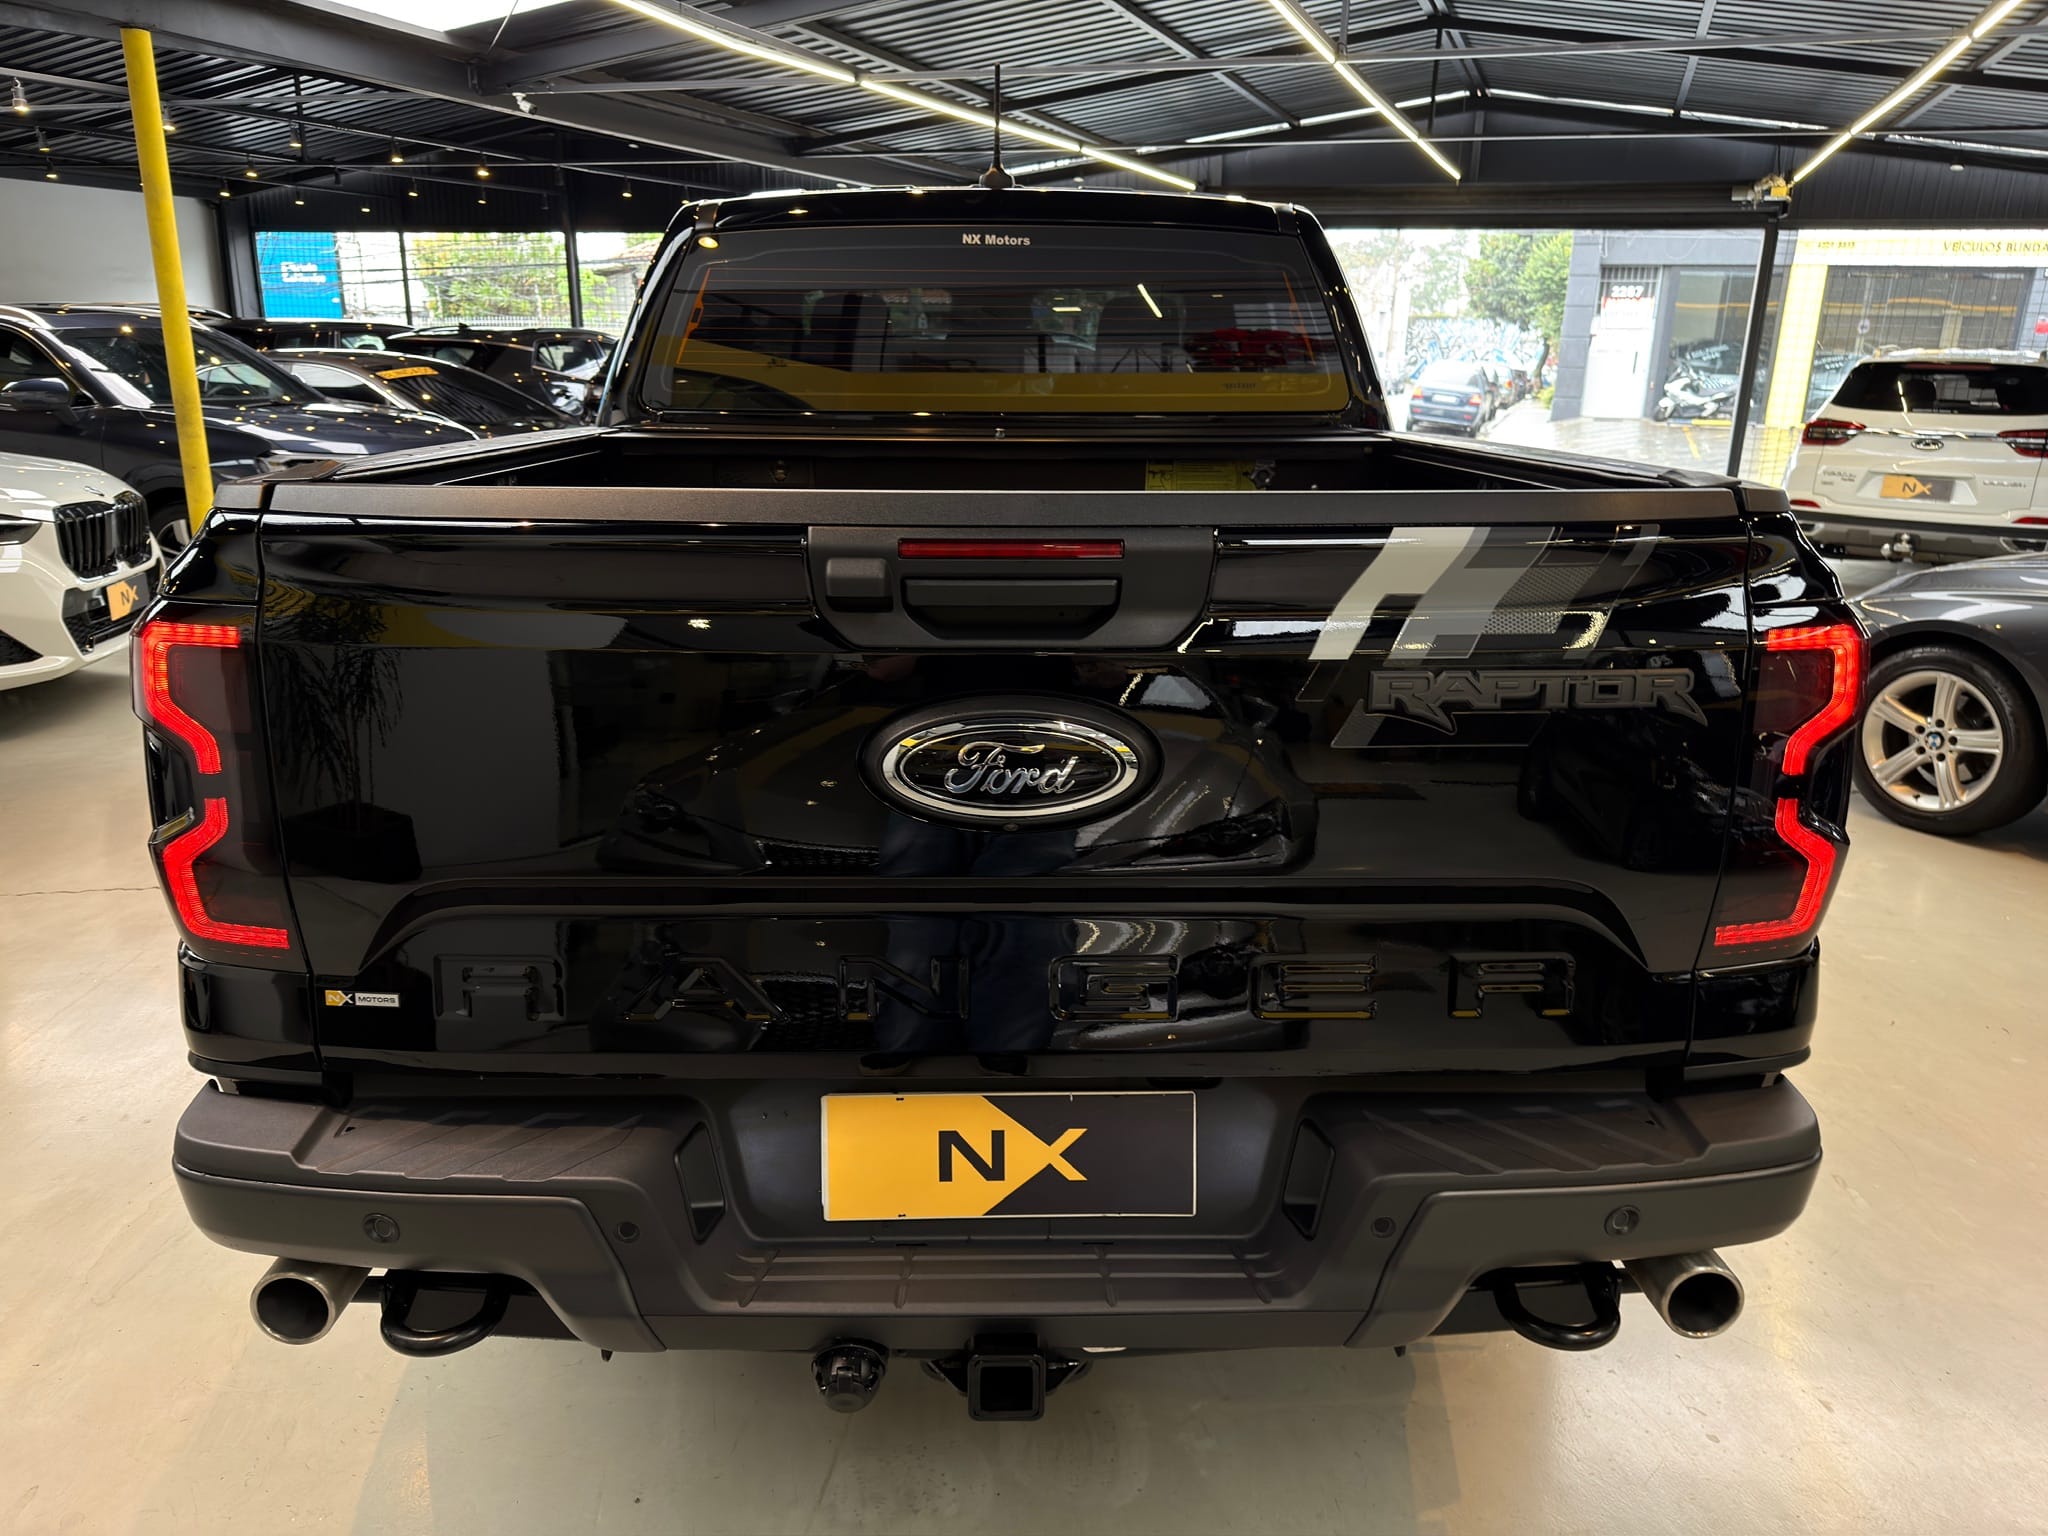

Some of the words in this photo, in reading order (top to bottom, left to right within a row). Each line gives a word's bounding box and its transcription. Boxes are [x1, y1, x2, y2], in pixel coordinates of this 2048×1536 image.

[962, 233, 981, 245] NX
[985, 234, 1031, 246] Motors
[1902, 481, 1933, 496] NX
[120, 585, 139, 606] NX
[1369, 668, 1708, 734] RAPTOR
[943, 740, 1080, 794] Ford
[358, 996, 396, 1004] MOTORS
[433, 952, 1576, 1021] RANGER
[938, 1128, 1089, 1183] NX
